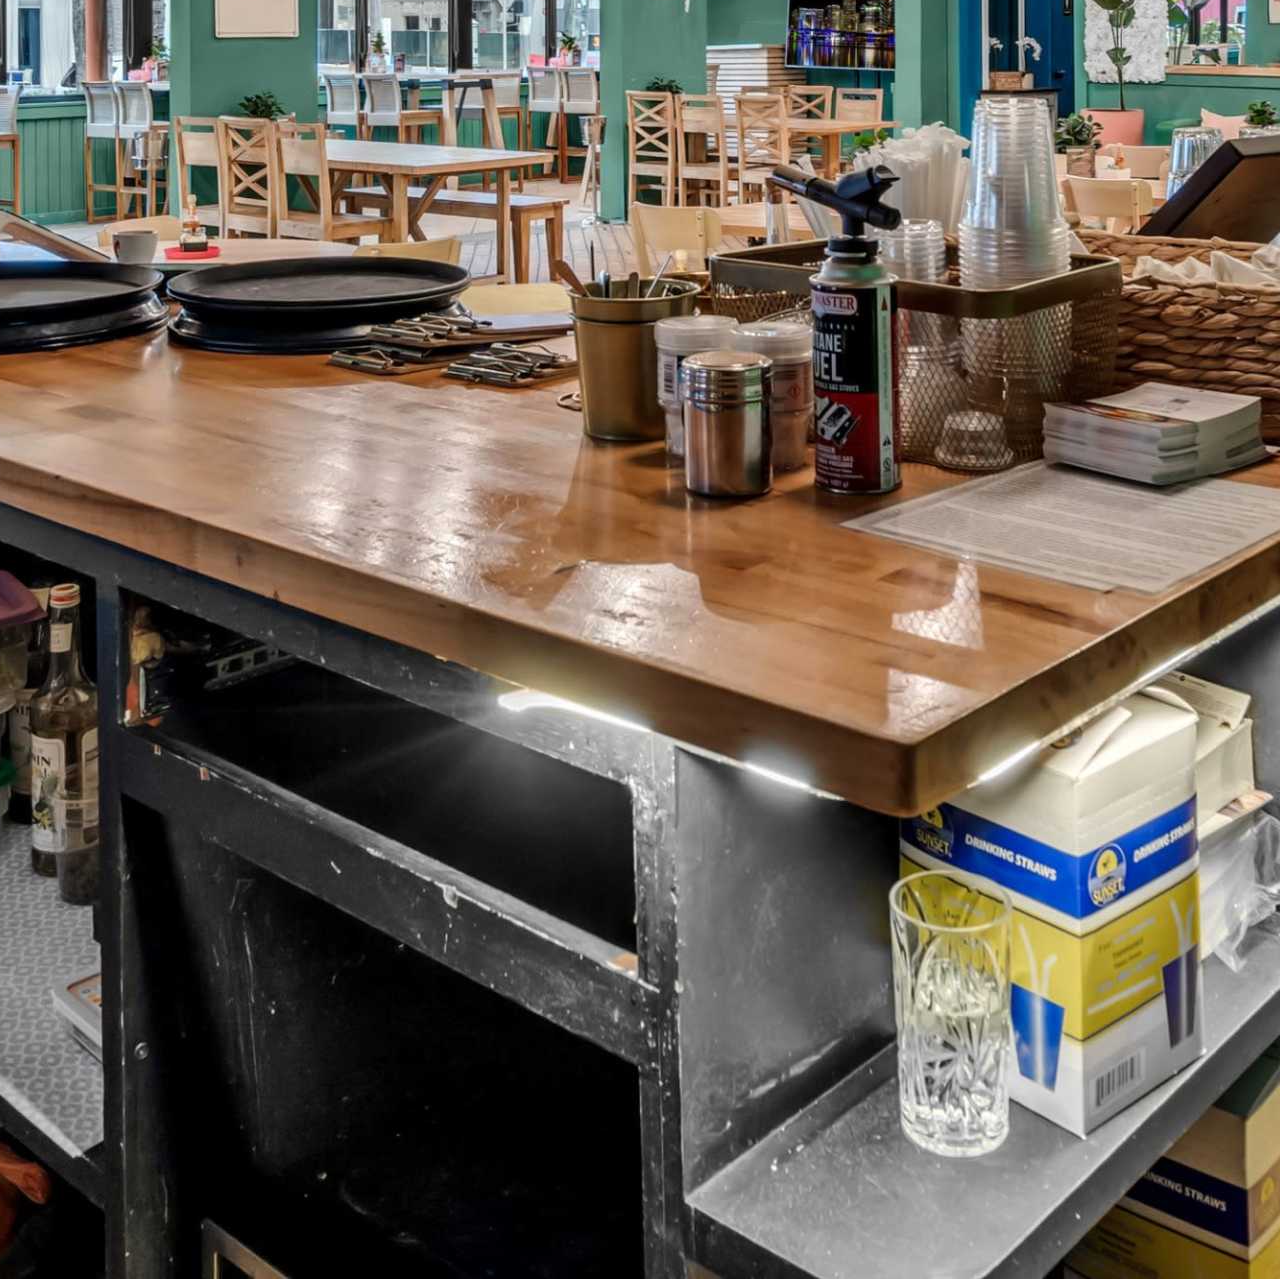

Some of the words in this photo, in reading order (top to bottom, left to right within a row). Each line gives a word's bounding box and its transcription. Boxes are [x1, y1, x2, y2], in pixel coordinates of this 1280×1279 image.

[917, 828, 950, 856] SUNSET
[1133, 832, 1170, 863] DRINKING
[965, 833, 1014, 863] DRINKING
[1015, 855, 1057, 881] STRAWS
[1093, 878, 1124, 901] SUNSET
[1184, 1186, 1227, 1212] STRAWS
